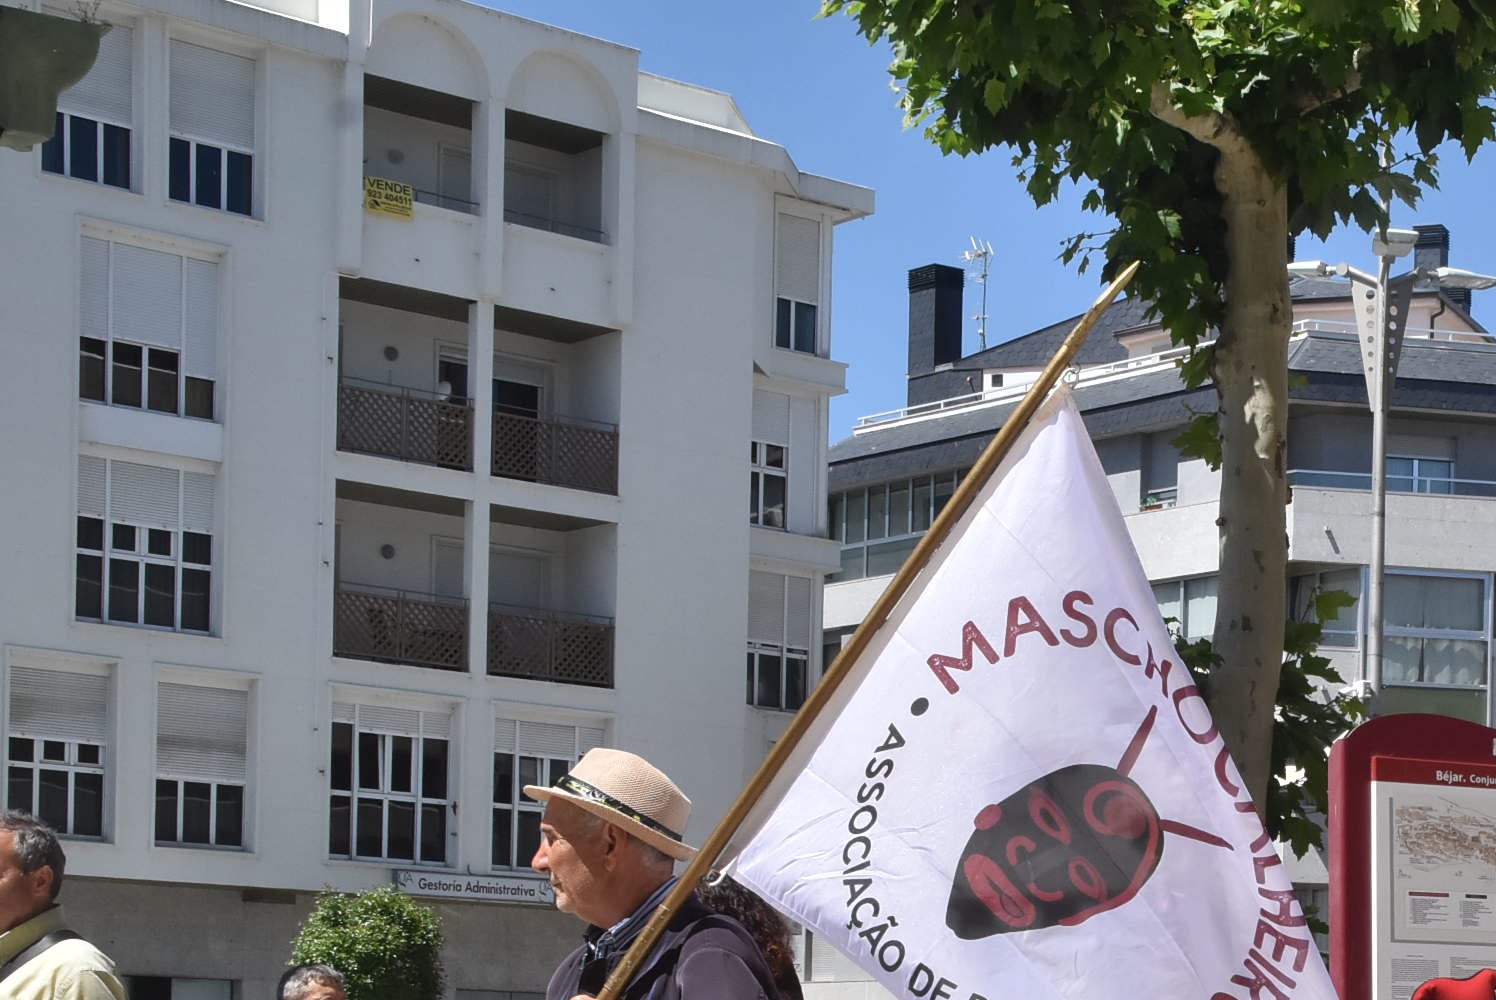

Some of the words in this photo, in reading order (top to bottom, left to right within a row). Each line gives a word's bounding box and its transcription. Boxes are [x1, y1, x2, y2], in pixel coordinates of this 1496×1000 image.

[367, 177, 411, 196] VENDE
[1436, 770, 1467, 784] Béjar.
[842, 722, 906, 973] ASSOCIAÇÃO
[465, 881, 535, 897] Administrativa
